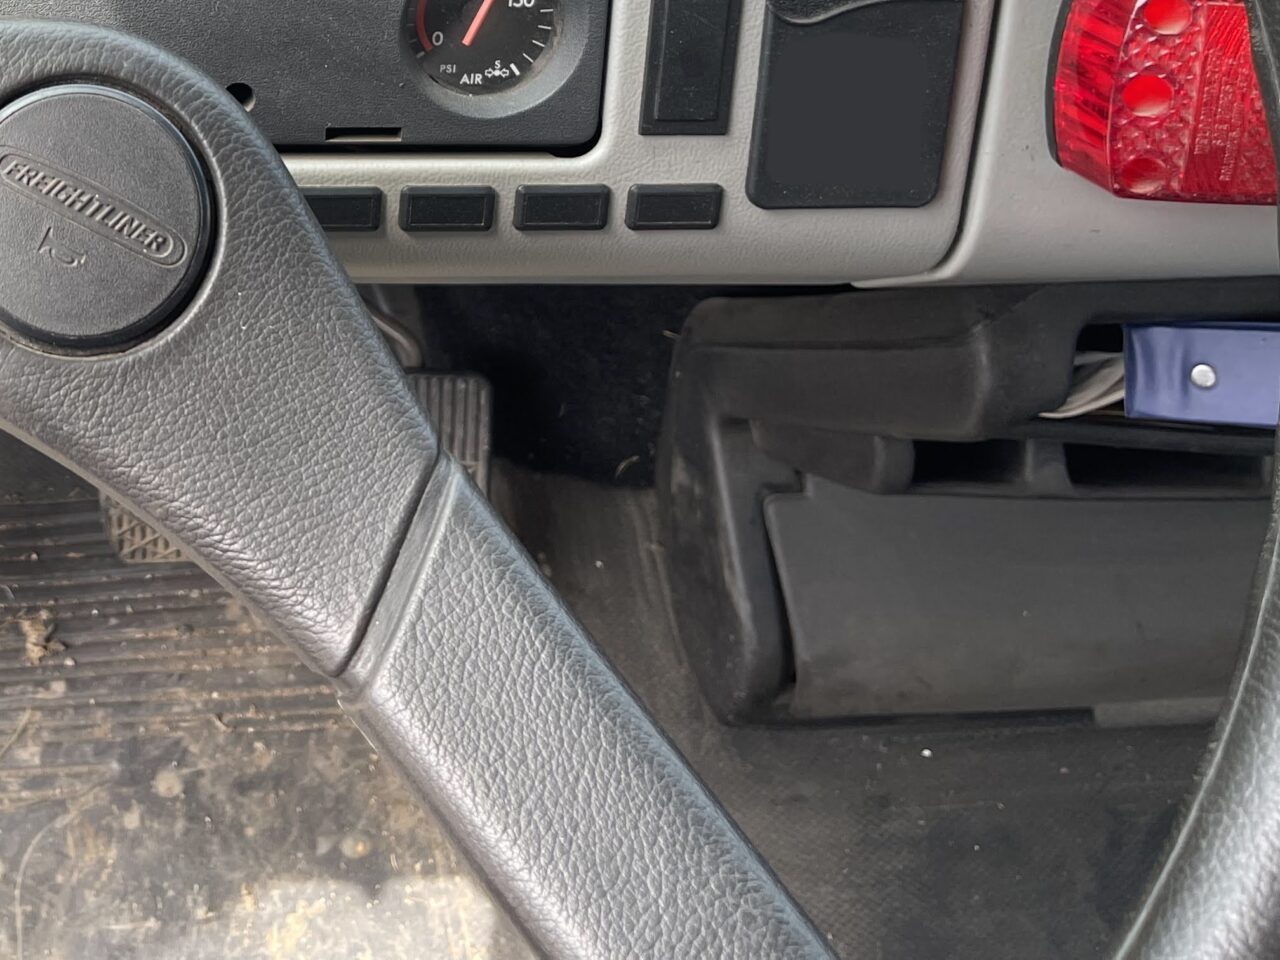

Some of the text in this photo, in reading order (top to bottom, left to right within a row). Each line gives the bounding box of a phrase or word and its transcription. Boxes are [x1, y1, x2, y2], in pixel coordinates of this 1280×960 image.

[432, 31, 443, 46] 0
[440, 64, 456, 73] PSI
[460, 73, 482, 84] AIR
[3, 159, 167, 251] FREIGHTLINER
